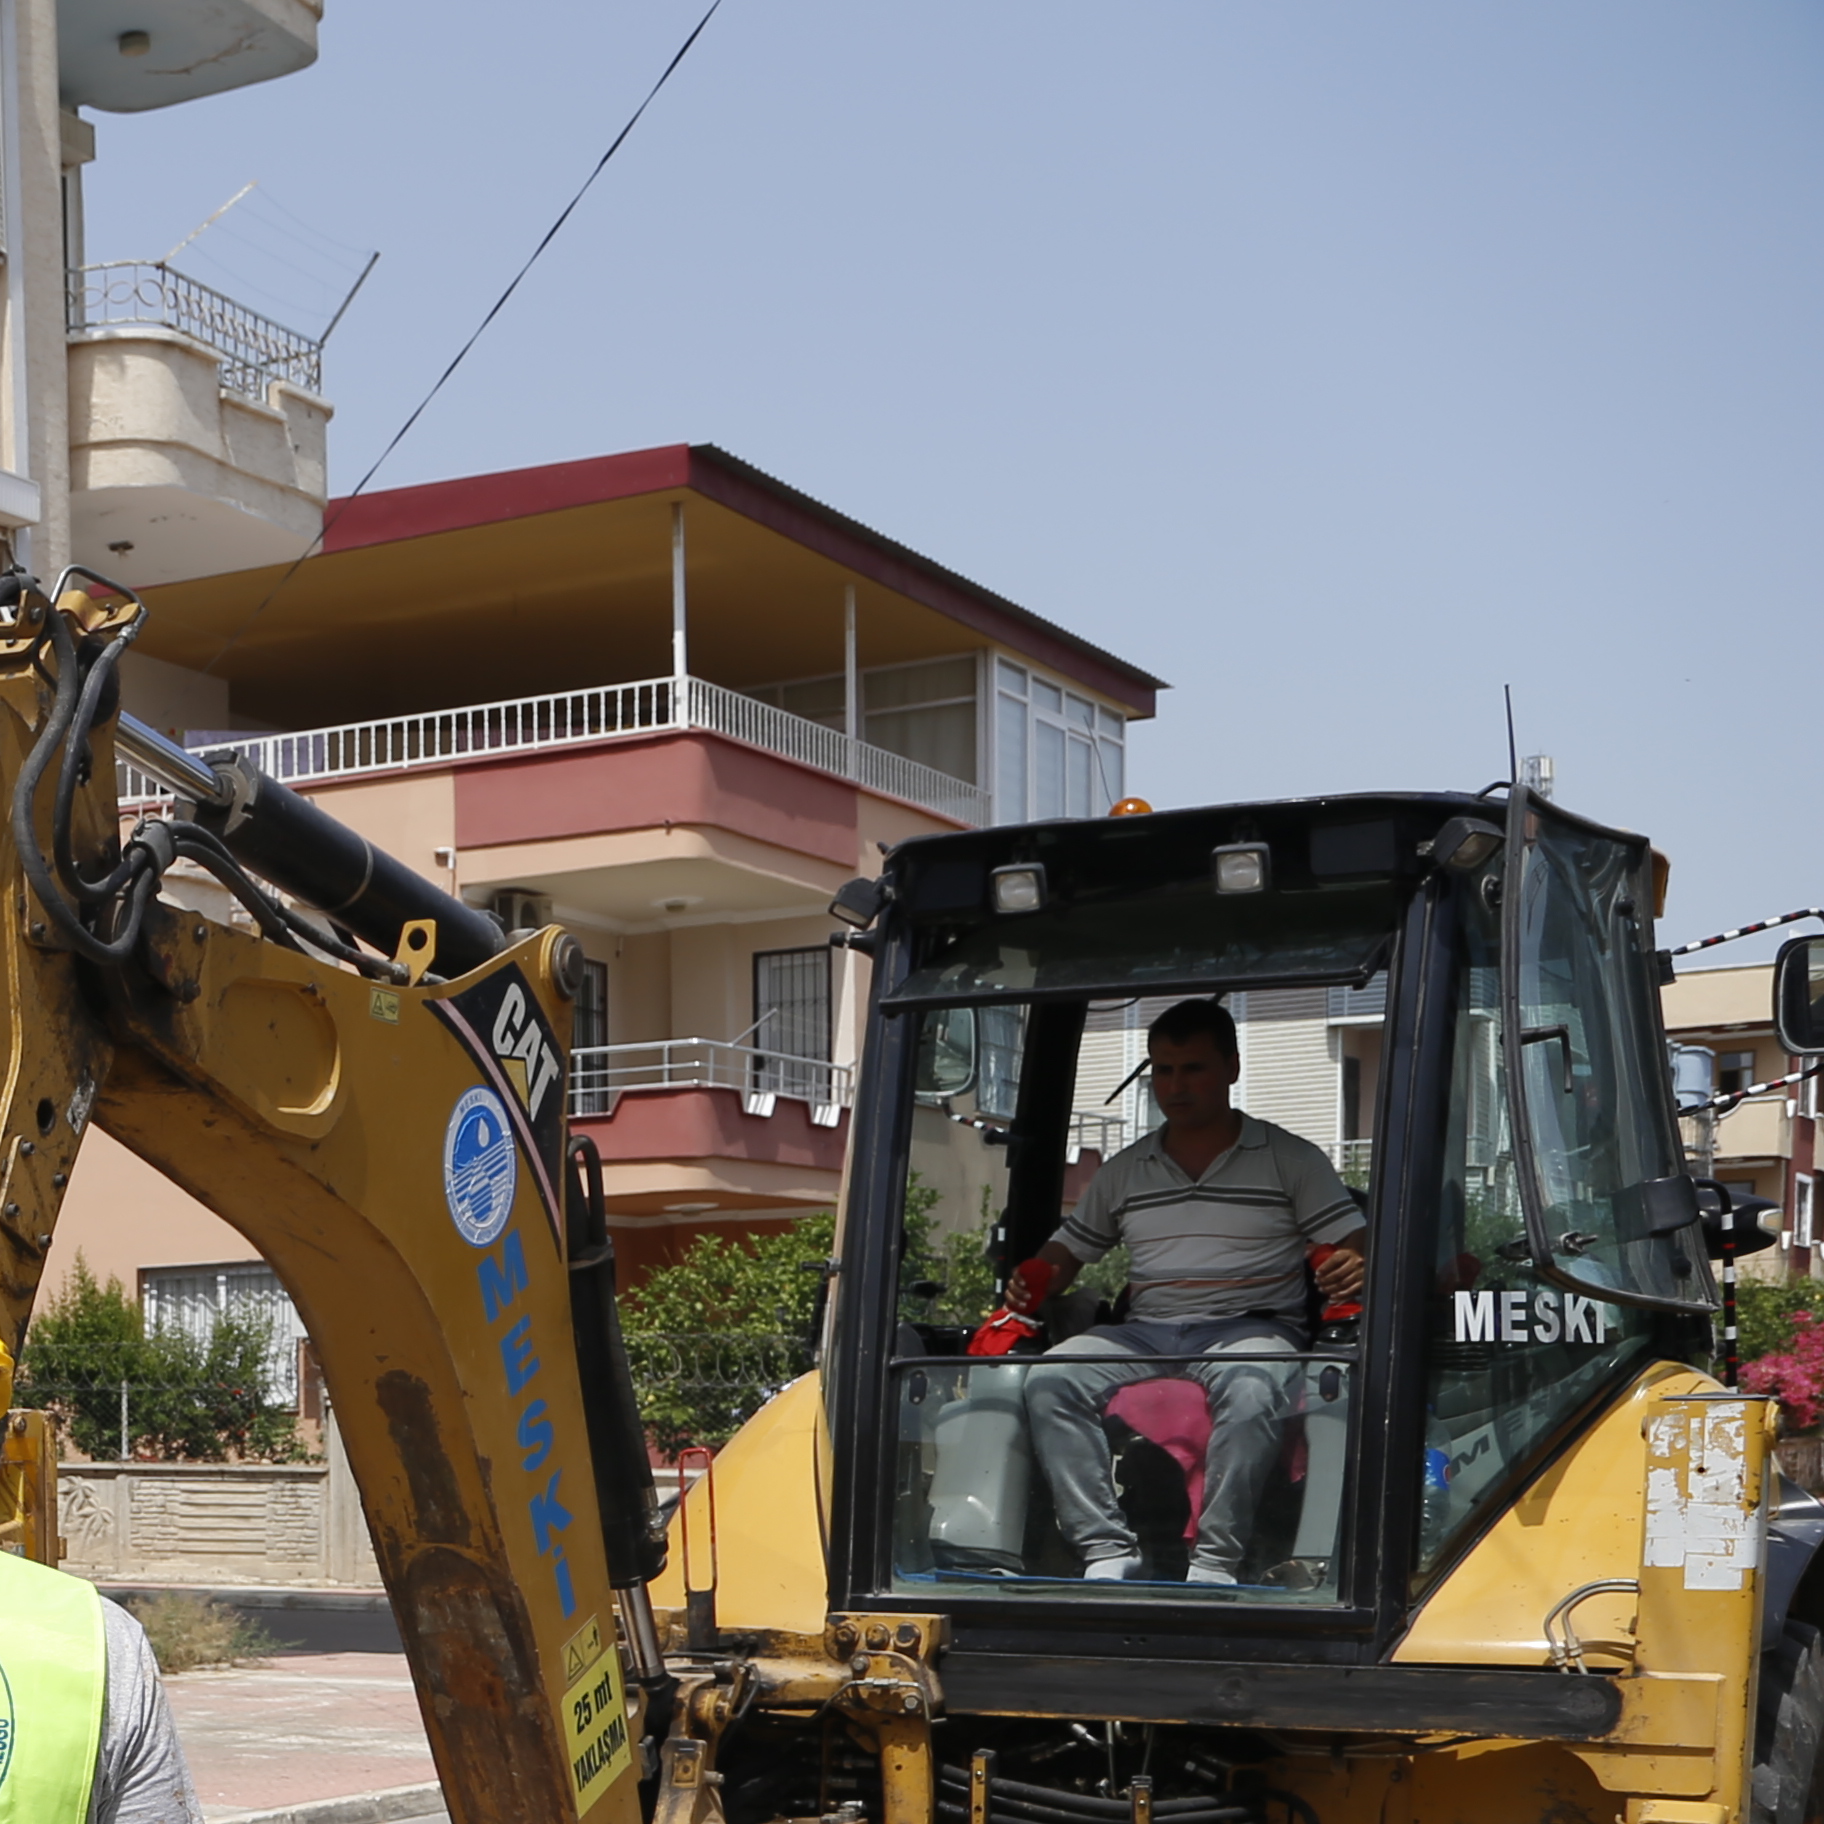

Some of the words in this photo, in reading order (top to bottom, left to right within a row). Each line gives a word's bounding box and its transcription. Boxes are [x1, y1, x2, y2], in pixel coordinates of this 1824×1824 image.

[492, 982, 560, 1123] CAT
[476, 1228, 577, 1620] MESKİ
[573, 1713, 627, 1793] YAKLAŞMA
[574, 1691, 592, 1736] 25
[594, 1670, 614, 1715] mt
